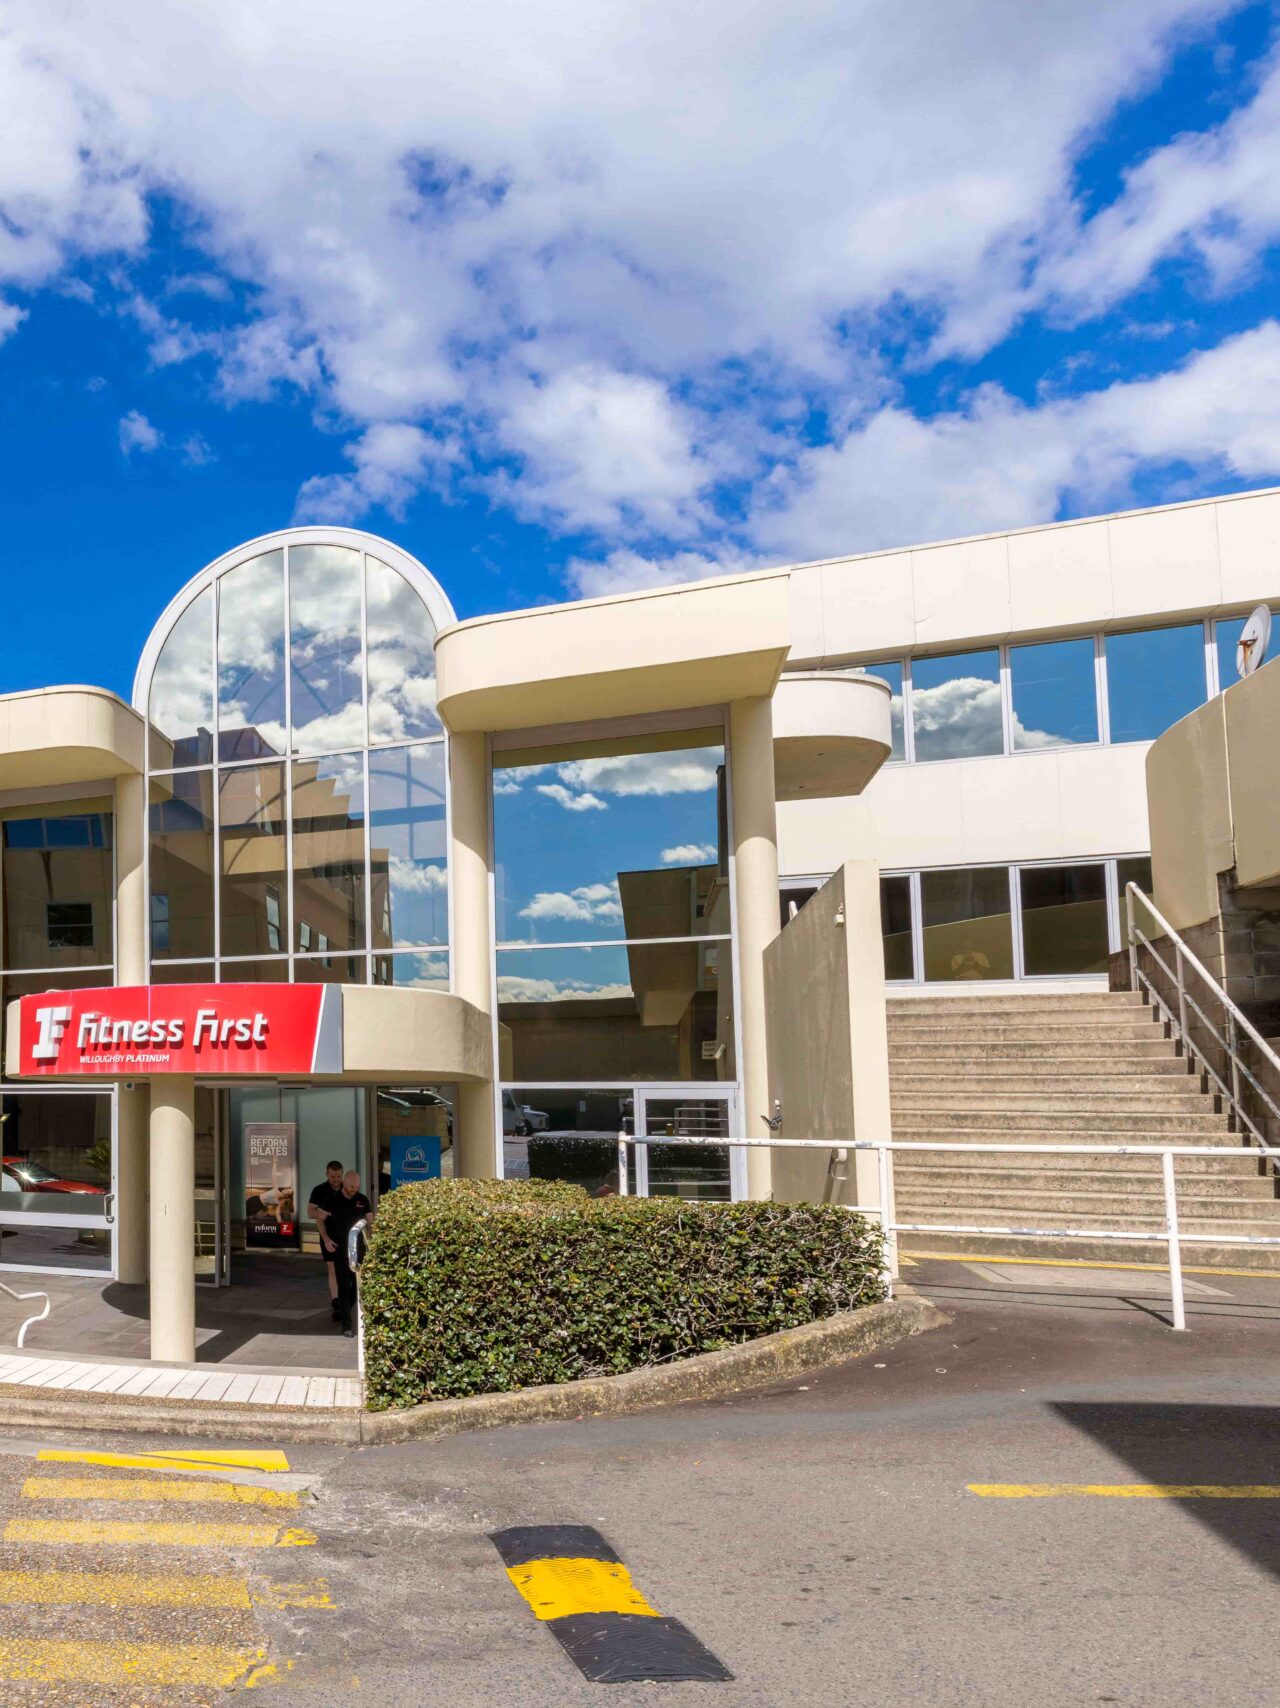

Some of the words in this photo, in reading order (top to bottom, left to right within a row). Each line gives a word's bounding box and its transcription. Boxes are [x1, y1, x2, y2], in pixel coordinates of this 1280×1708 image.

[77, 1013, 184, 1048] Fitness
[192, 1009, 268, 1046] First
[80, 1055, 125, 1064] WILLOUGHBY
[126, 1054, 170, 1063] PLATINUM
[250, 1138, 288, 1146] REFORM
[250, 1147, 288, 1156] PILATES
[254, 1223, 277, 1231] reform
